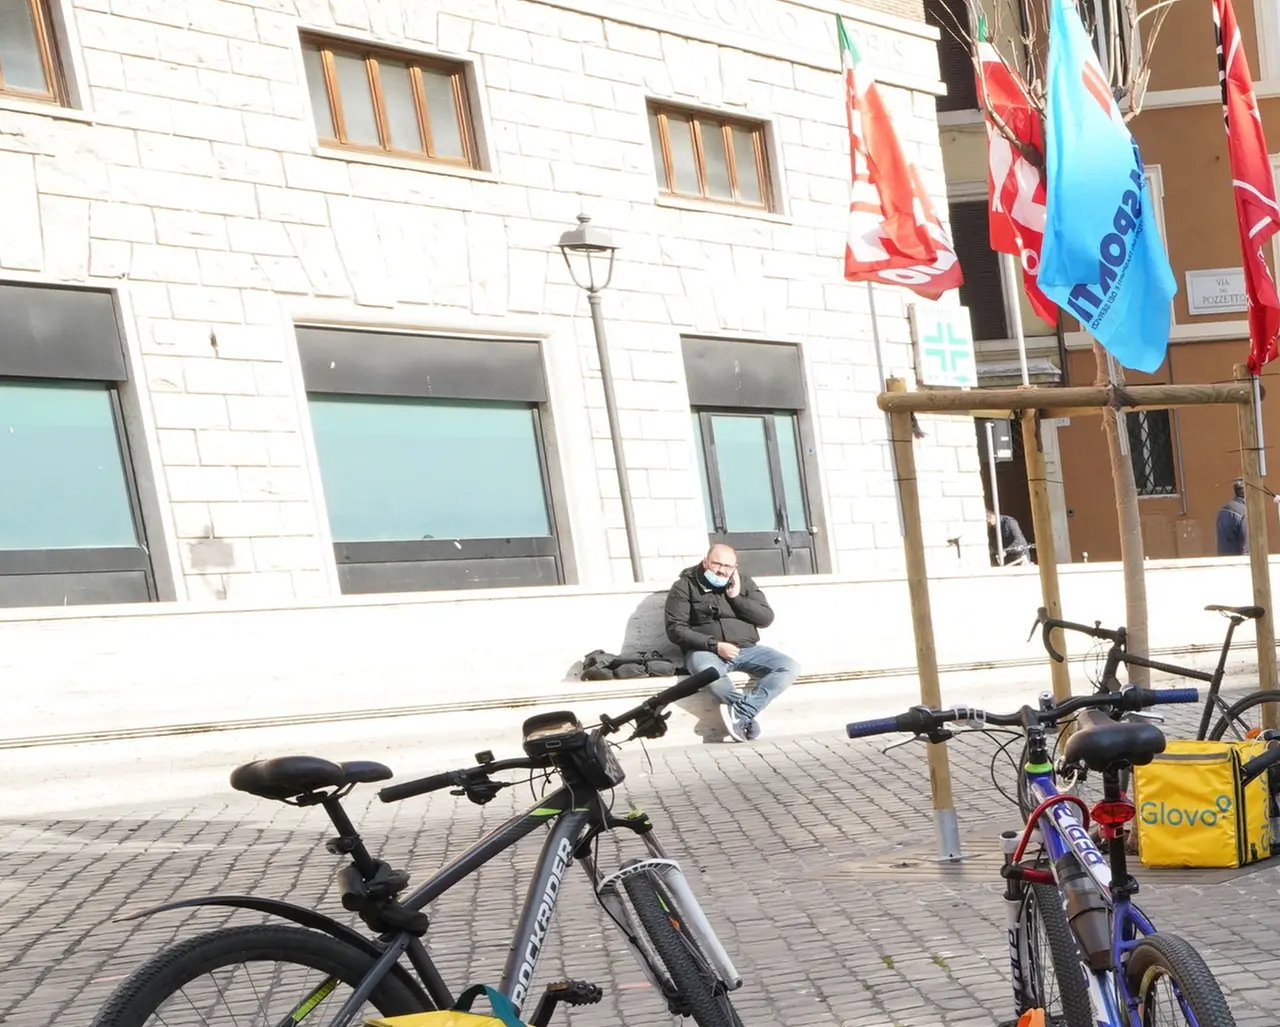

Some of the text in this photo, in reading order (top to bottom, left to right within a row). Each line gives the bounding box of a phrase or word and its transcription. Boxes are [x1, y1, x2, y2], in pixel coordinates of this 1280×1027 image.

[1215, 278, 1230, 286] VIA
[1202, 294, 1246, 305] POZZETTO
[1140, 801, 1218, 827] Glovo
[511, 837, 573, 1009] ROCKRIDER
